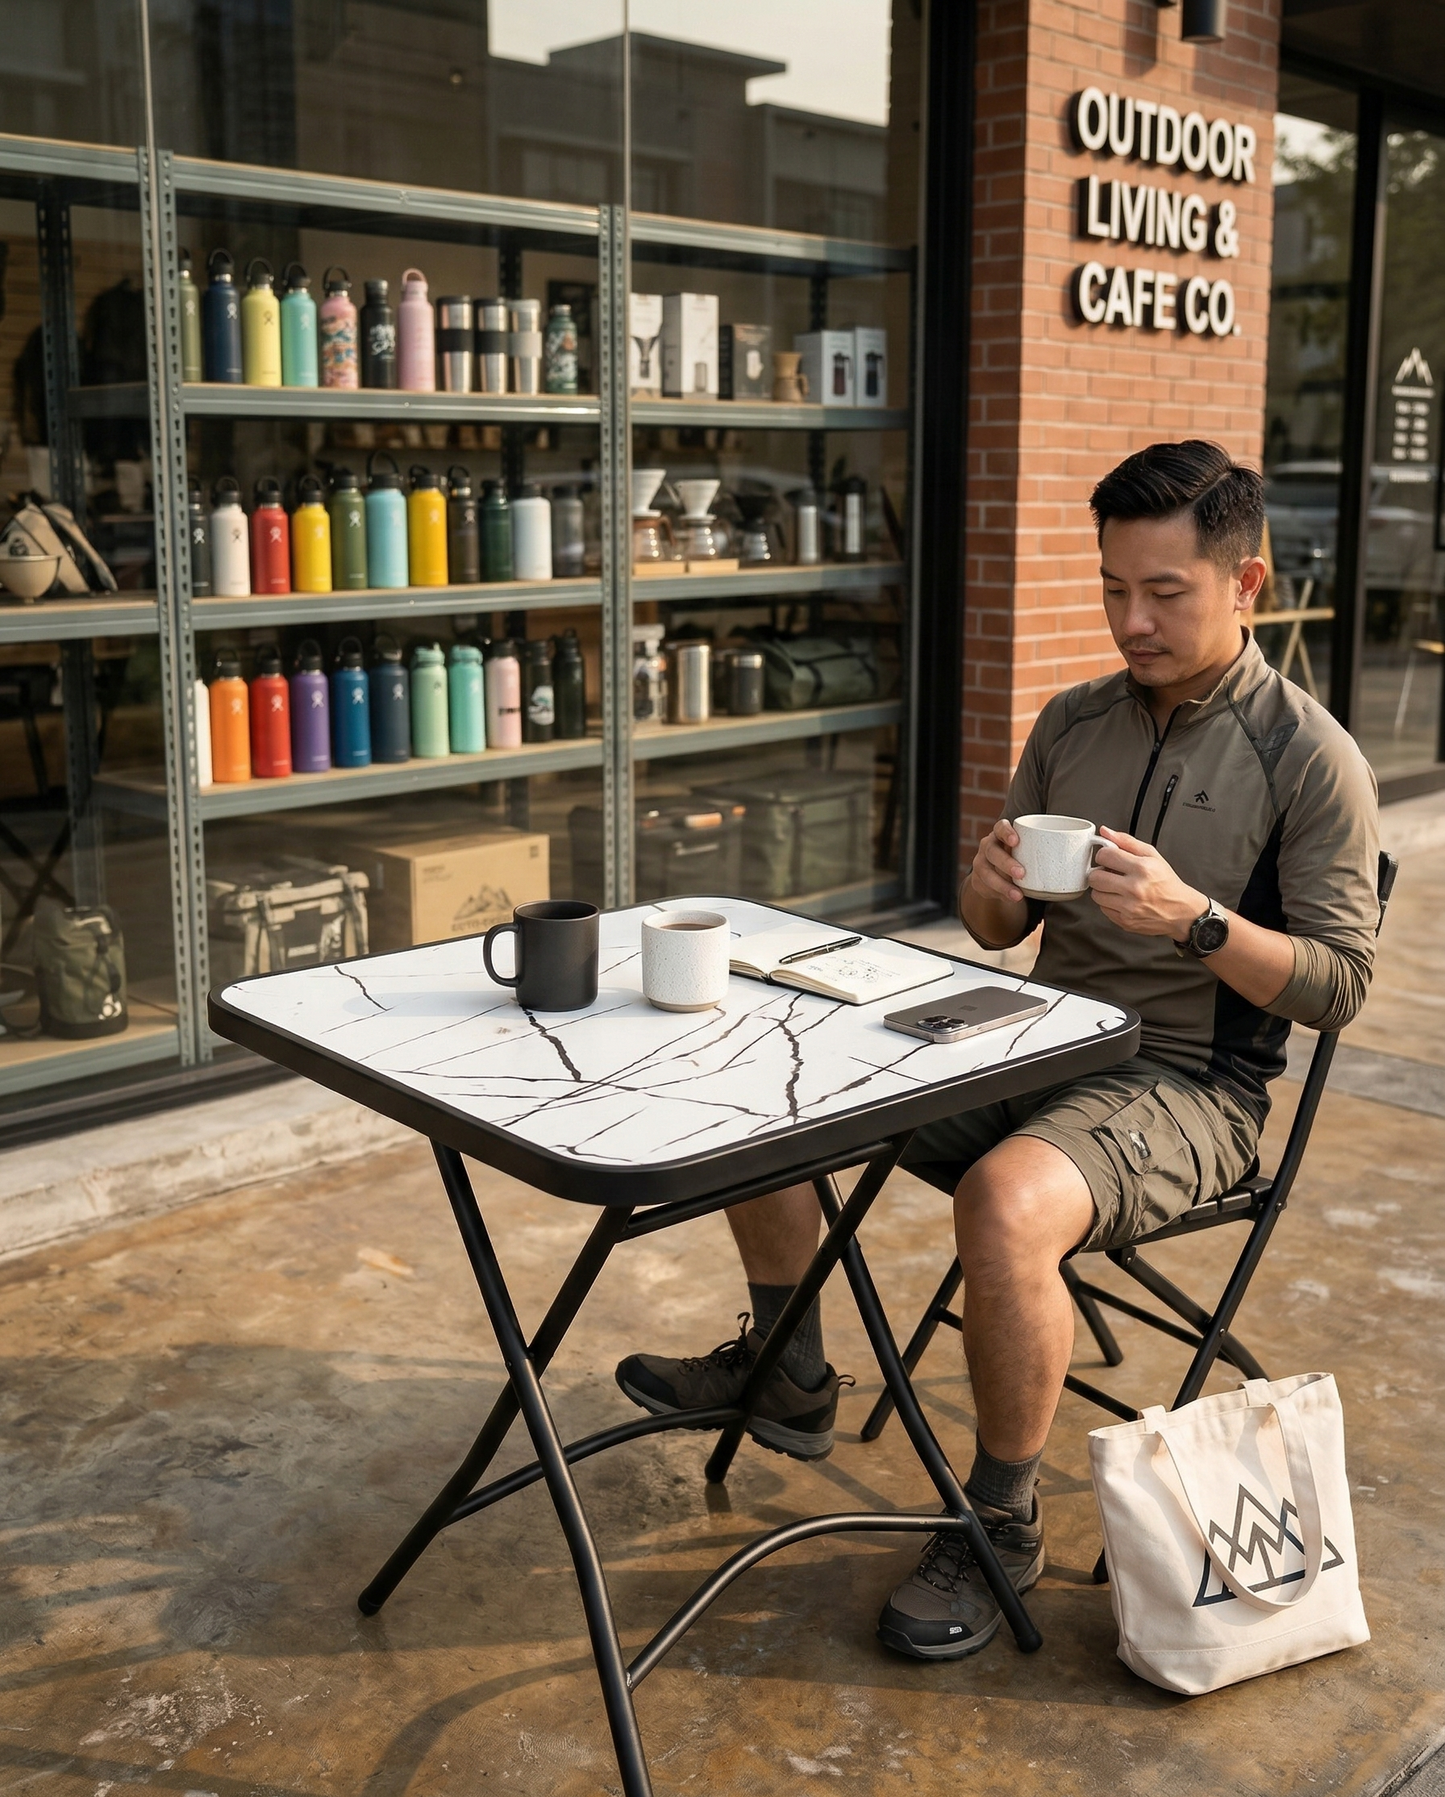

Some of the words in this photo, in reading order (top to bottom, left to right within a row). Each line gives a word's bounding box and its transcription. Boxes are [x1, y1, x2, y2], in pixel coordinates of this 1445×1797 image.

[1077, 86, 1257, 183] OUTDOOR
[1087, 174, 1207, 252] LIVING
[1214, 199, 1239, 259] &
[1079, 261, 1178, 331] CAFE
[1184, 276, 1242, 337] CO.
